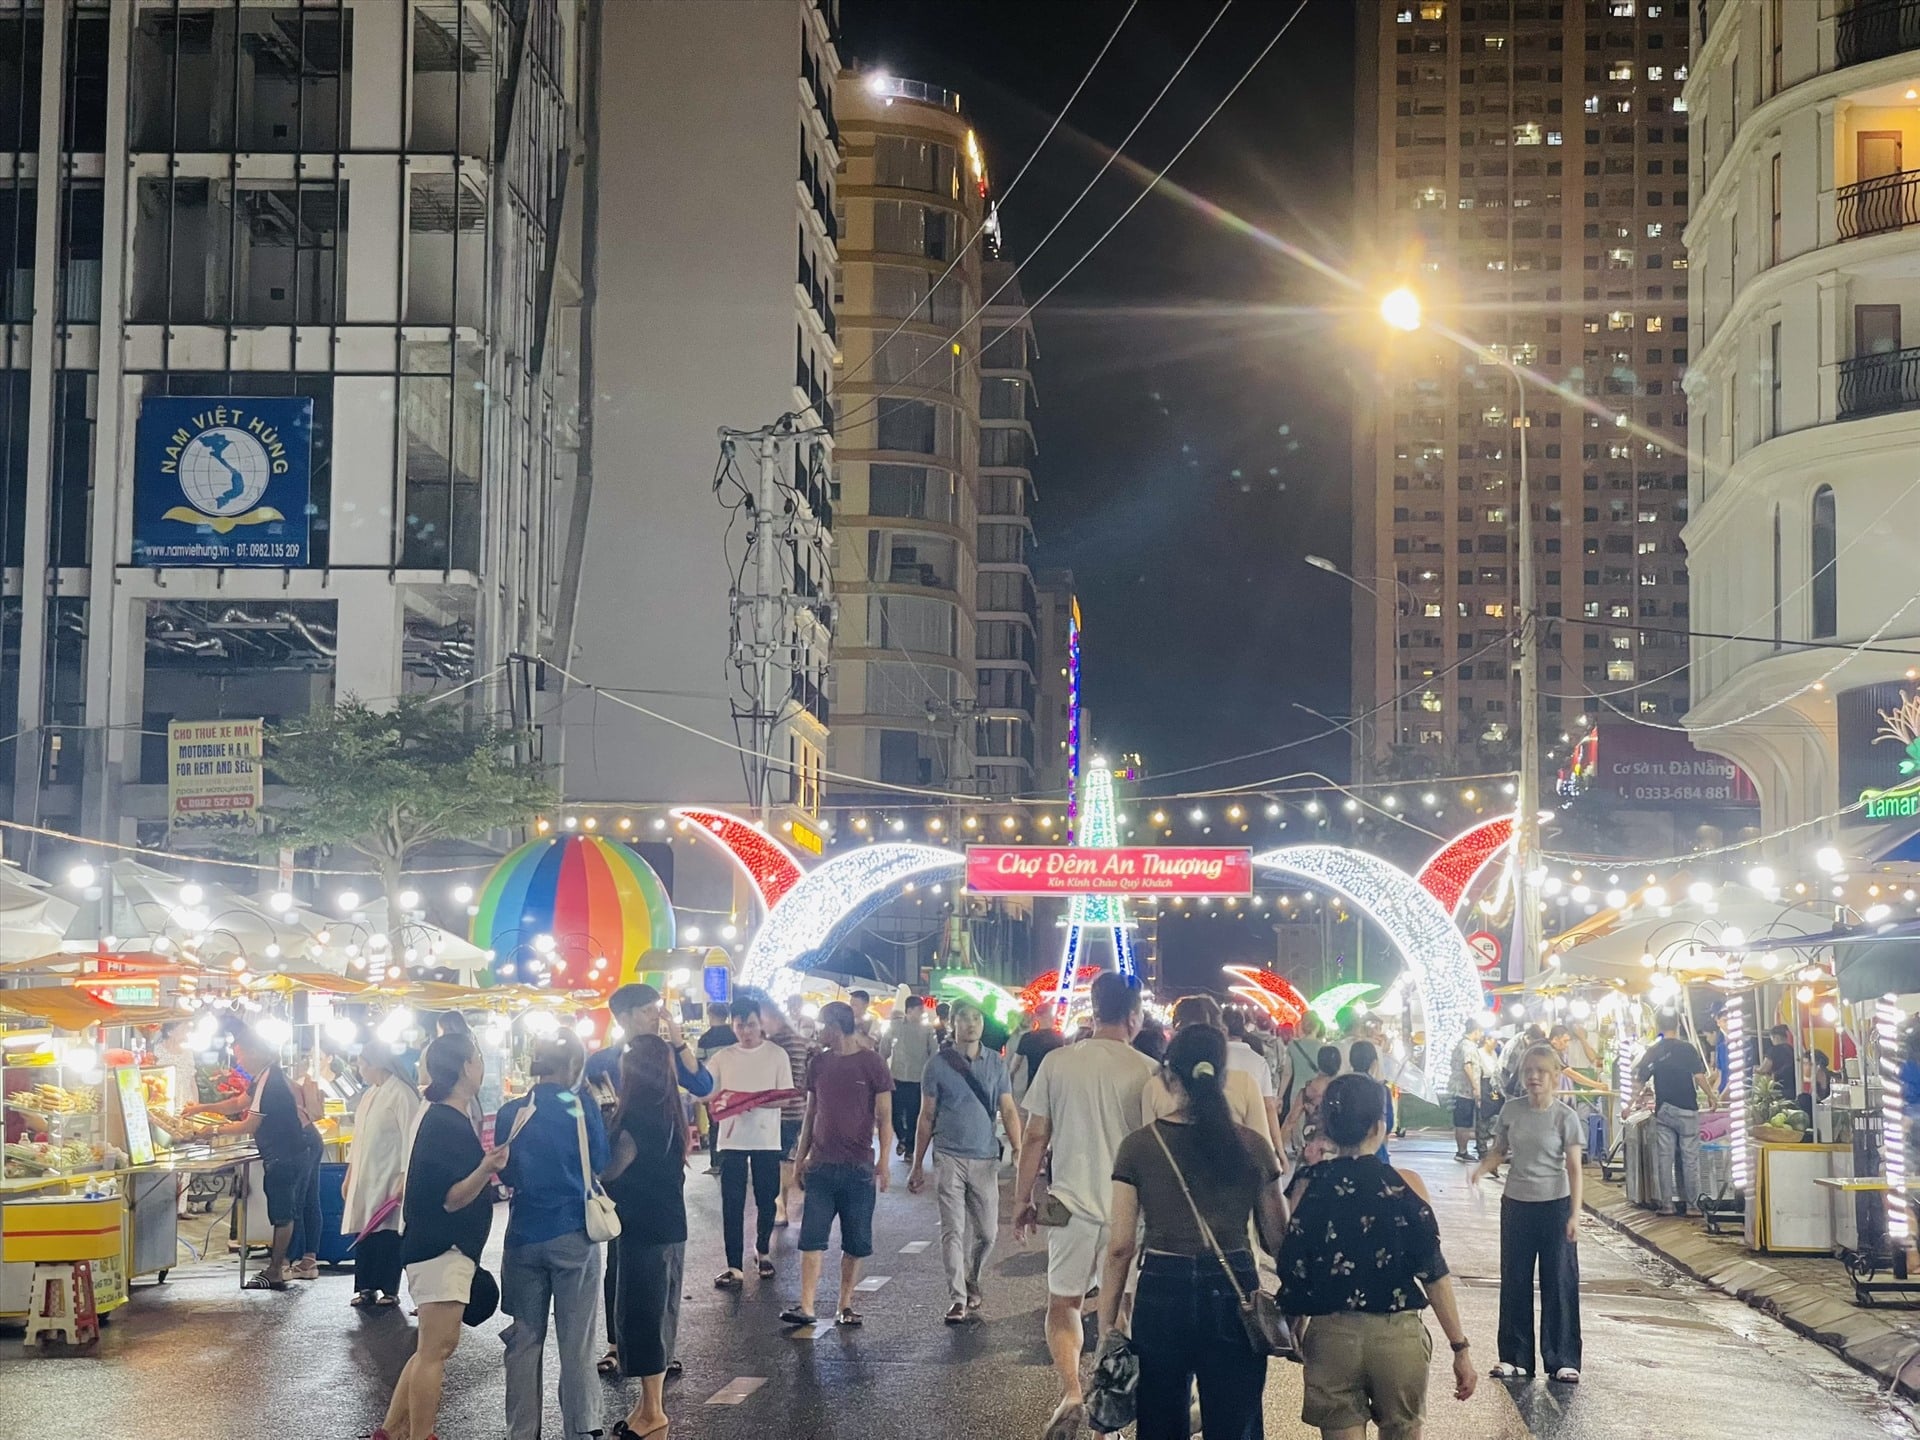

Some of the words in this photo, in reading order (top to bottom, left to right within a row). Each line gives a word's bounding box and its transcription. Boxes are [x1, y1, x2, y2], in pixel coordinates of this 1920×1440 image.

[161, 427, 191, 474] NAM
[192, 405, 243, 429] VIỆT
[144, 543, 230, 560] www.namviethung.vn
[173, 728, 192, 740] CHO
[220, 727, 231, 738] XE
[179, 743, 226, 759] MOTORBIKE
[176, 762, 191, 776] FOR
[194, 761, 213, 775] RENT
[216, 761, 232, 775] AND
[235, 760, 253, 774] SELL
[1669, 760, 1691, 776] Đà
[997, 852, 1041, 878] Chợ
[1046, 852, 1097, 875] Đêm
[1102, 853, 1134, 875] An
[1142, 853, 1223, 879] Thượng
[1142, 877, 1173, 888] Khách
